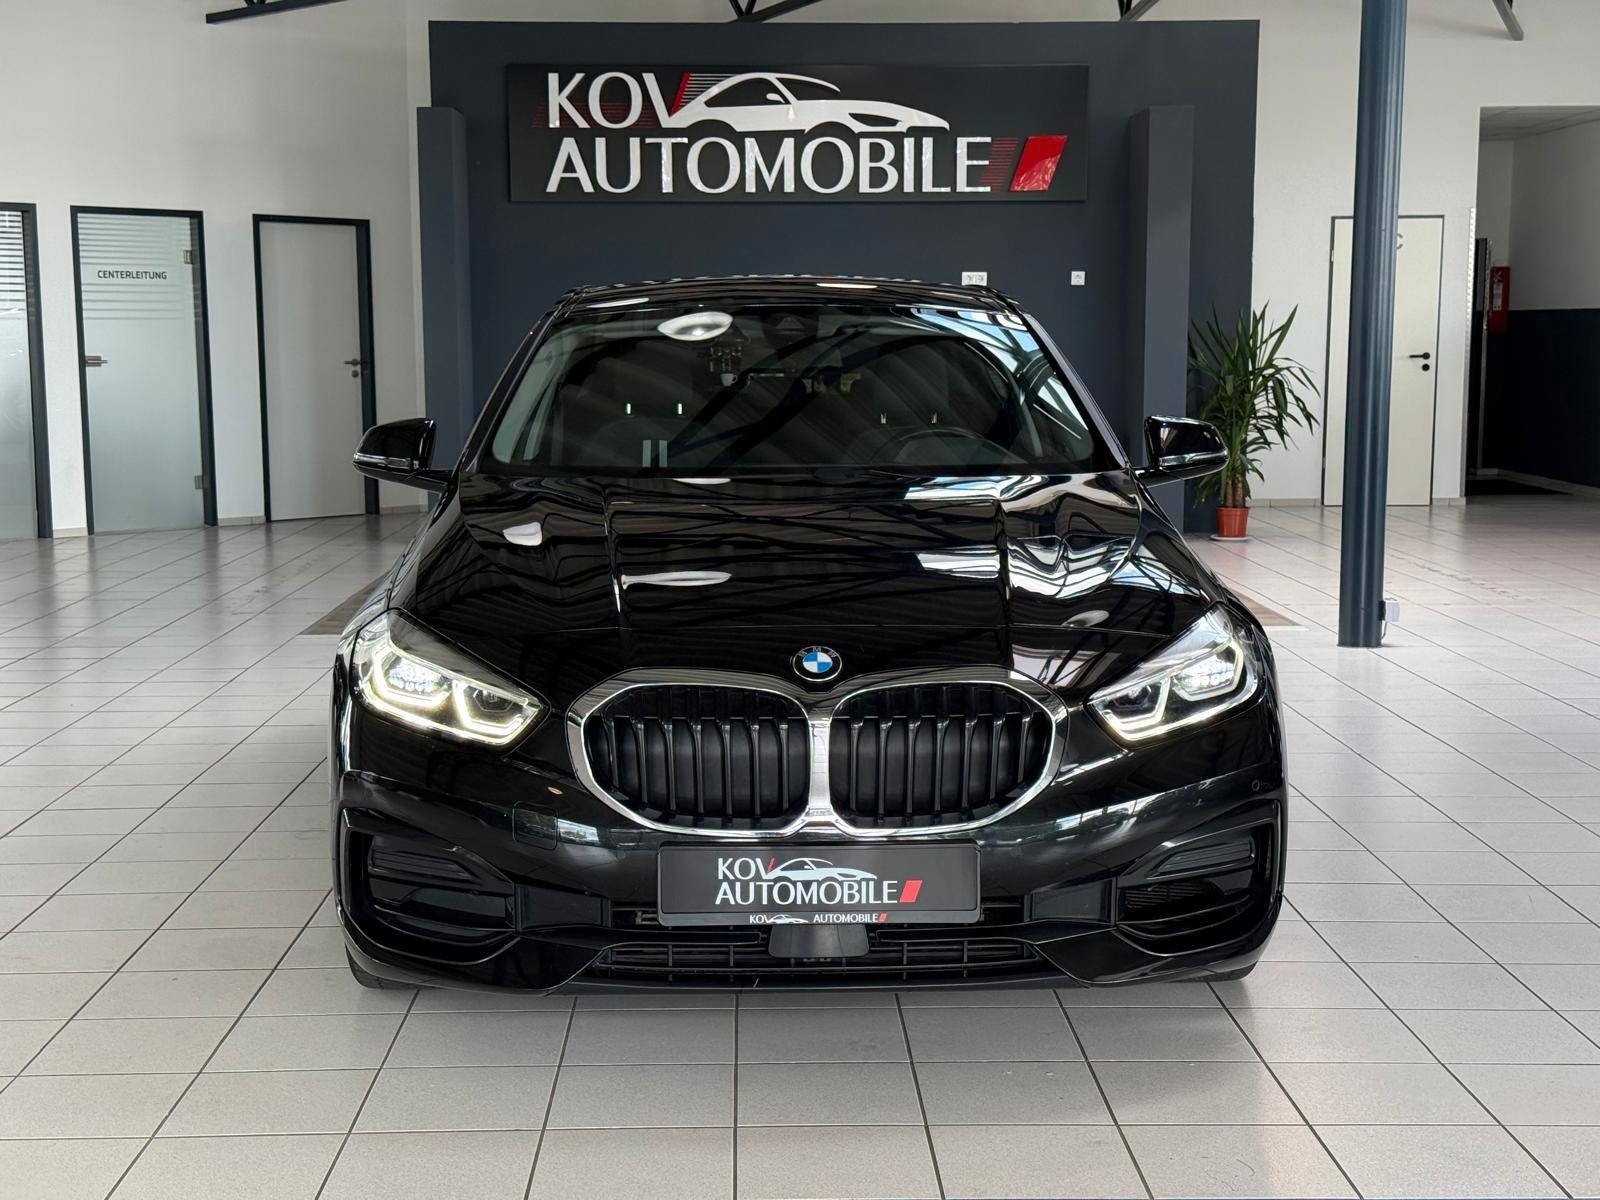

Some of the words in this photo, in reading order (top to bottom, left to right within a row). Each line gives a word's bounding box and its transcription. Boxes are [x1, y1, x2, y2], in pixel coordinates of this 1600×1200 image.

[547, 72, 691, 129] KOV
[546, 137, 992, 193] AUTOMOBILE
[97, 270, 168, 280] CENTERLEITUNG
[717, 857, 775, 880] KOV
[715, 880, 898, 905] AUTOMOBILE
[813, 913, 879, 923] AUTOMOBILE
